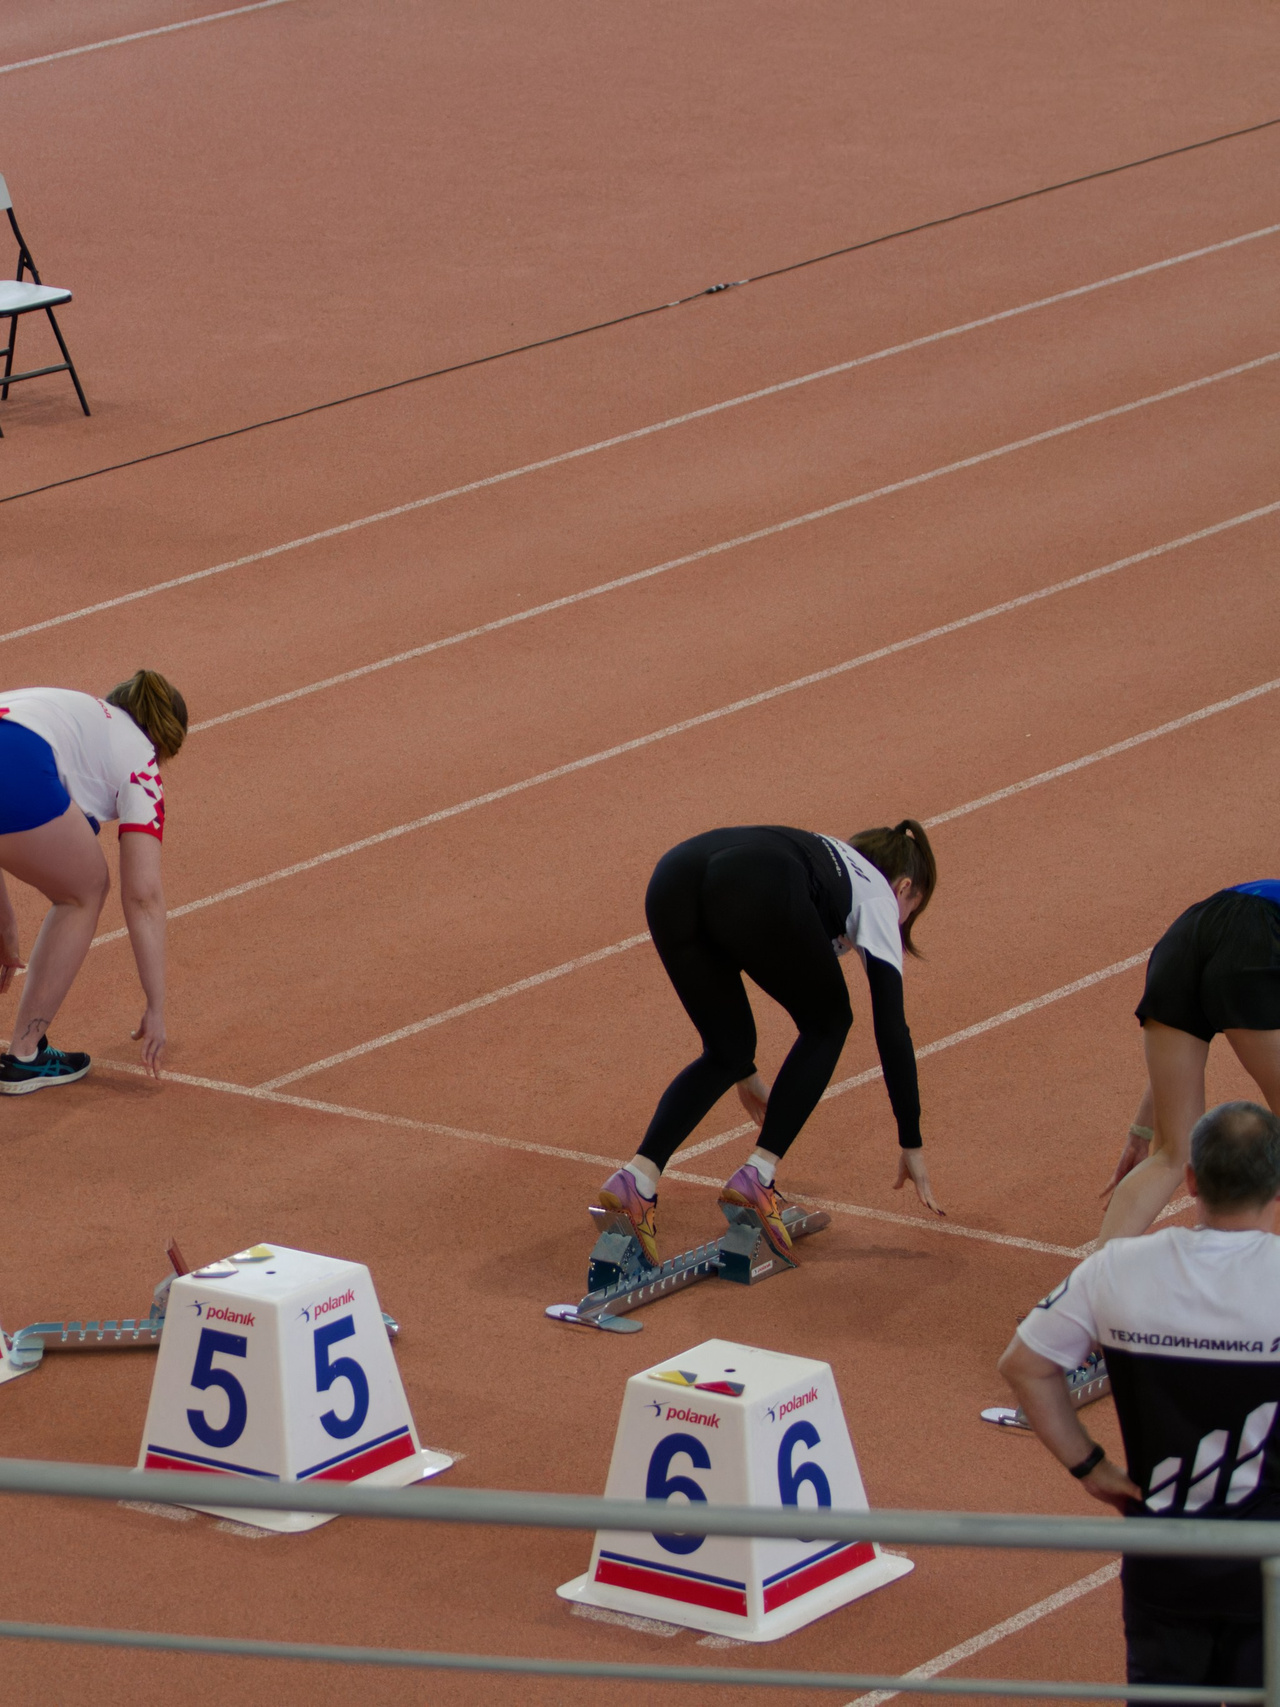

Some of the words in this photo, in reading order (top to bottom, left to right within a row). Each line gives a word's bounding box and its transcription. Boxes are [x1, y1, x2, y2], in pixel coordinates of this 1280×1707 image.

[206, 1305, 256, 1327] polanik
[314, 1288, 356, 1320] polanik
[1109, 1328, 1264, 1353] ТЕХНОДИНАМИКА
[186, 1327, 248, 1448] 5
[313, 1314, 370, 1440] 5
[666, 1406, 721, 1429] polanik
[778, 1386, 819, 1421] polanik
[645, 1432, 712, 1555] 6
[777, 1420, 833, 1543] 6
